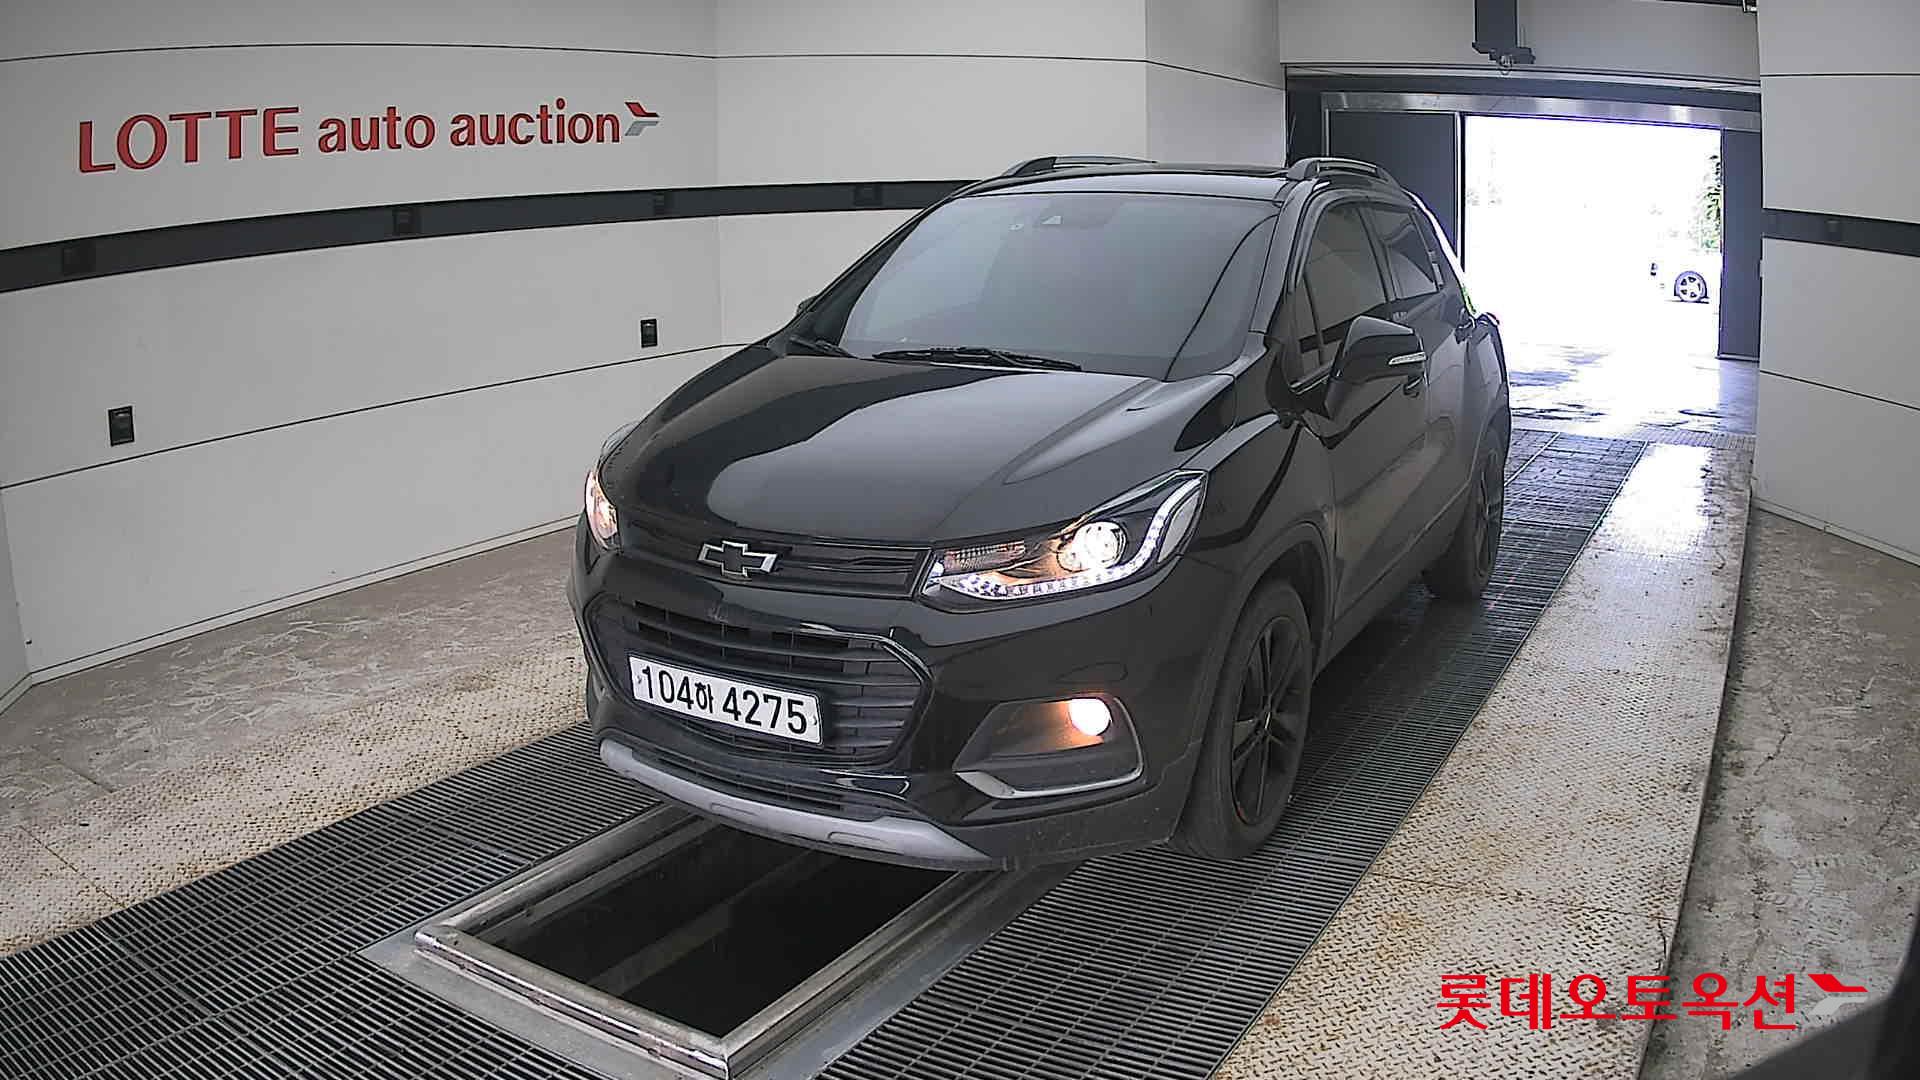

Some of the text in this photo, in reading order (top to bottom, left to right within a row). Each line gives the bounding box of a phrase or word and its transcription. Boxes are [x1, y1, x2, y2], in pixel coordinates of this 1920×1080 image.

[79, 98, 621, 173] LOTTE auto auction
[641, 666, 807, 735] 104하 4275
